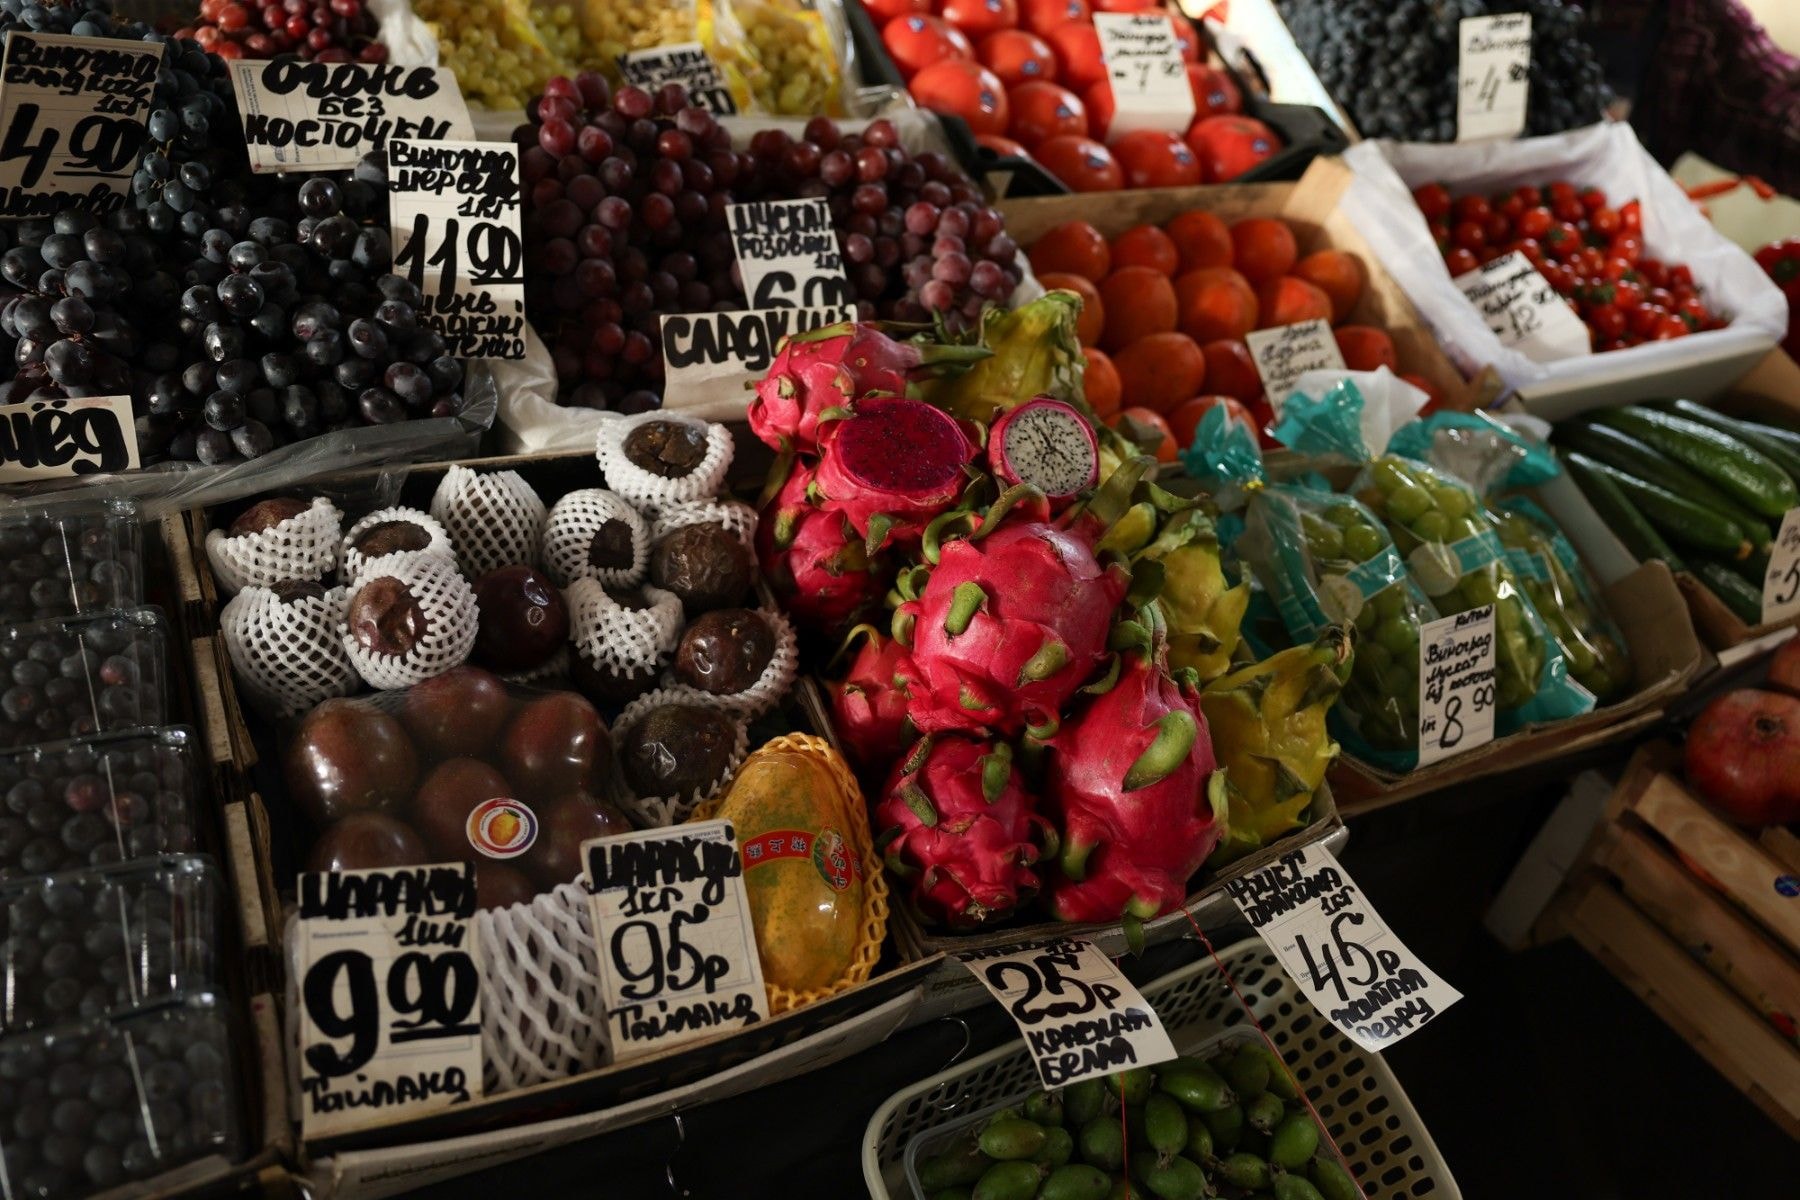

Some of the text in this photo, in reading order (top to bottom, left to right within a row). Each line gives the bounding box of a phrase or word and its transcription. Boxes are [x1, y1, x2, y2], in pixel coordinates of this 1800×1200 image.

[0, 103, 146, 188] 4 90
[395, 213, 522, 302] 11 90
[1424, 632, 1492, 665] Виноград
[1426, 655, 1481, 685] Мускат
[1439, 696, 1464, 749] 8
[1472, 684, 1496, 713] 90
[618, 885, 685, 919] 1кг
[303, 949, 480, 1078] 9 90
